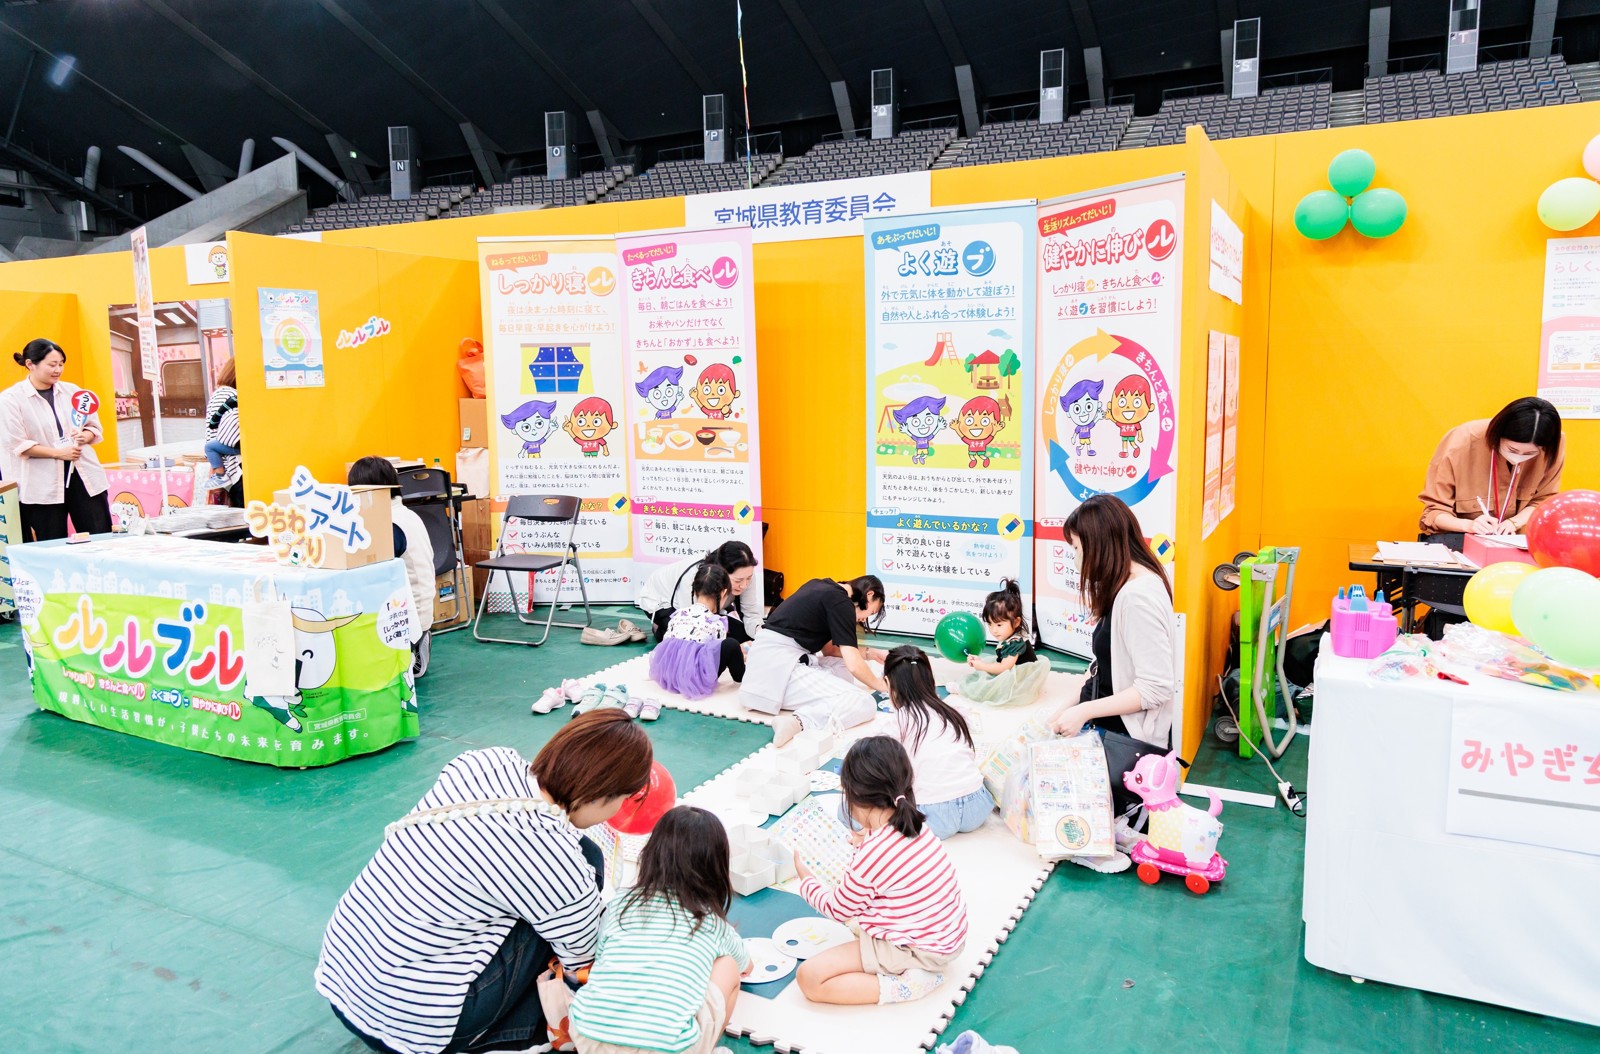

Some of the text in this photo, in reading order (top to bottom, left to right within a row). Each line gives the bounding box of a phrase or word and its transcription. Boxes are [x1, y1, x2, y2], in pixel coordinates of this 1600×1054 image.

[710, 131, 718, 141] P
[397, 161, 404, 171] N
[338, 317, 389, 346] ルルブル
[80, 395, 90, 411] うえ
[295, 474, 354, 516] シール
[248, 506, 306, 535] うちわ
[309, 508, 365, 547] アート
[521, 541, 601, 549] すいみん時間をっている
[896, 536, 951, 547] 天気の良い日は
[896, 548, 951, 559] 外で遊んでいる
[896, 562, 991, 576] いろいろな体験をしている
[890, 590, 935, 603] ルルブル
[57, 600, 245, 687] ルルブル
